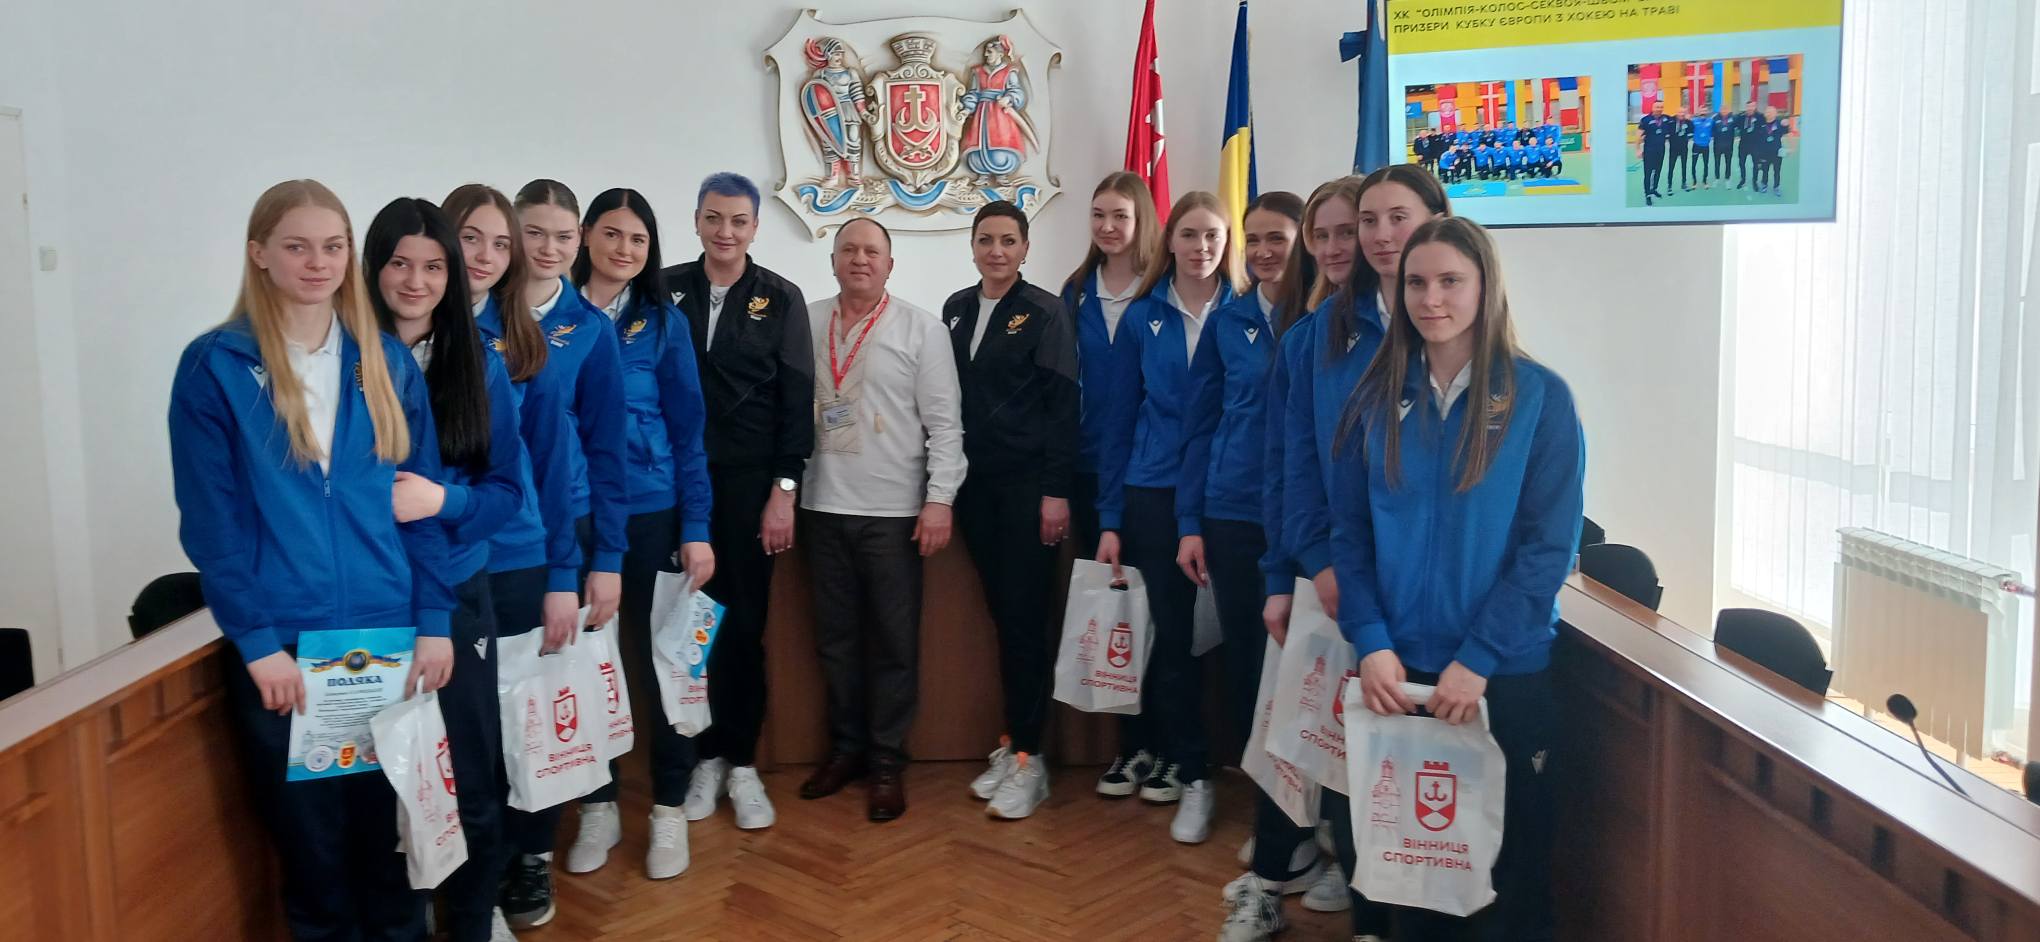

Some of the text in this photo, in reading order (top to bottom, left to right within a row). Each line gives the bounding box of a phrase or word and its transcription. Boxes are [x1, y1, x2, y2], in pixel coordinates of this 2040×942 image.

[1394, 21, 1449, 34] ПРИЗЕРИ
[1456, 18, 1496, 30] КУБКУ
[1499, 14, 1551, 26] ЄВРОПИ
[1567, 9, 1616, 22] ХОКЕЮ
[1620, 8, 1638, 18] НА
[1642, 5, 1680, 17] ТРАВІ
[327, 675, 383, 687] ПОДЯКА
[1080, 678, 1138, 693] СПОРТИВНА
[1095, 670, 1137, 683] ВІННИЦЯ
[548, 743, 593, 762] ВІННИЦЯ
[1300, 729, 1347, 760] СПОРТИ
[535, 755, 597, 779] СПОРТИВНА
[1403, 837, 1469, 854] ВІННИЦЯ
[1383, 851, 1473, 872] СПОРТИВНА
